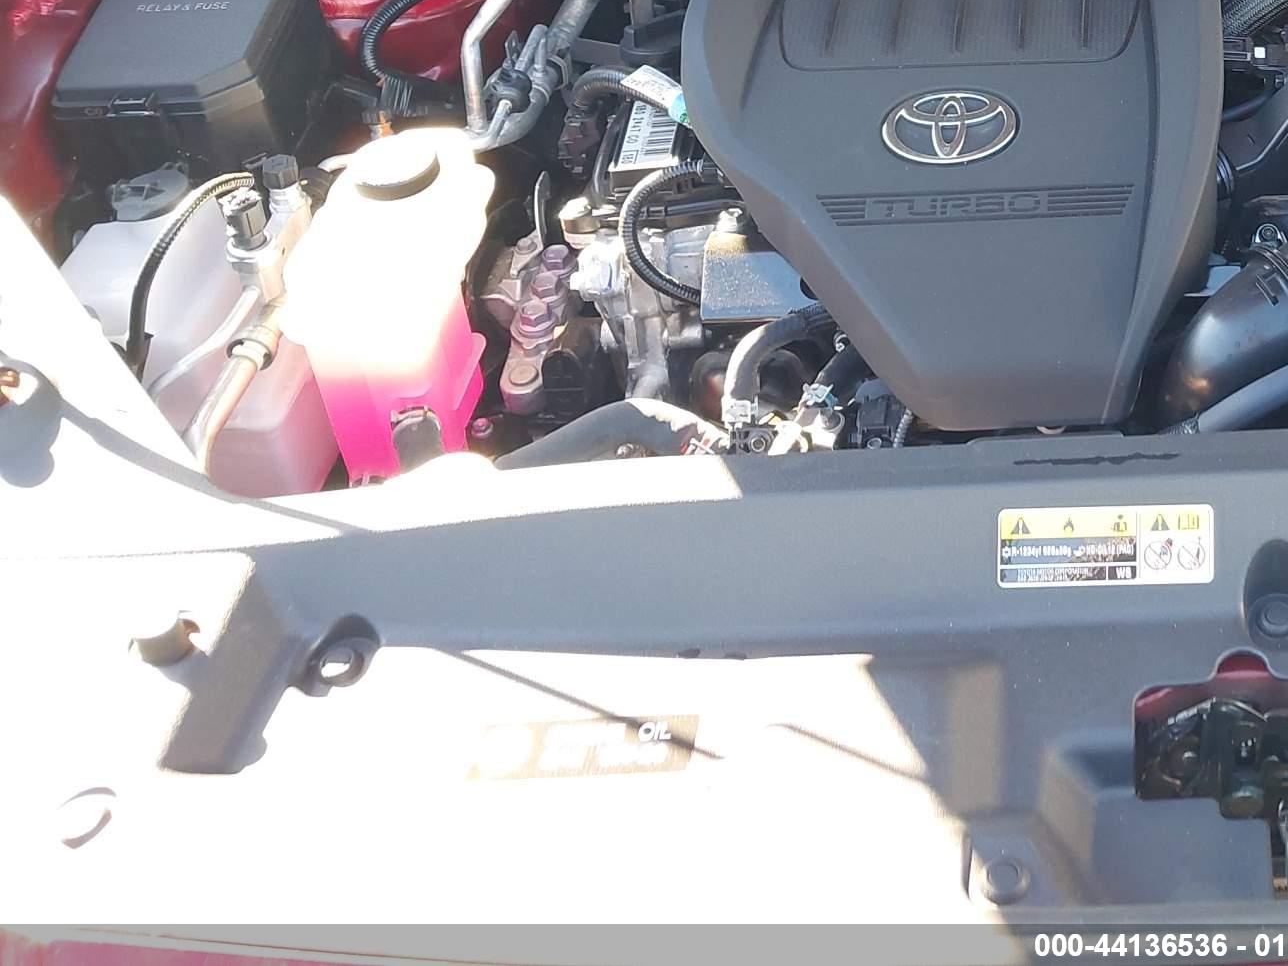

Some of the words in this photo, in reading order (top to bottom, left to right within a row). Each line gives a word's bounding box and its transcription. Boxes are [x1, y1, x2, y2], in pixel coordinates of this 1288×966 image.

[136, 3, 181, 13] RELAY
[194, 1, 230, 11] FUSE
[870, 193, 1042, 218] TURBO
